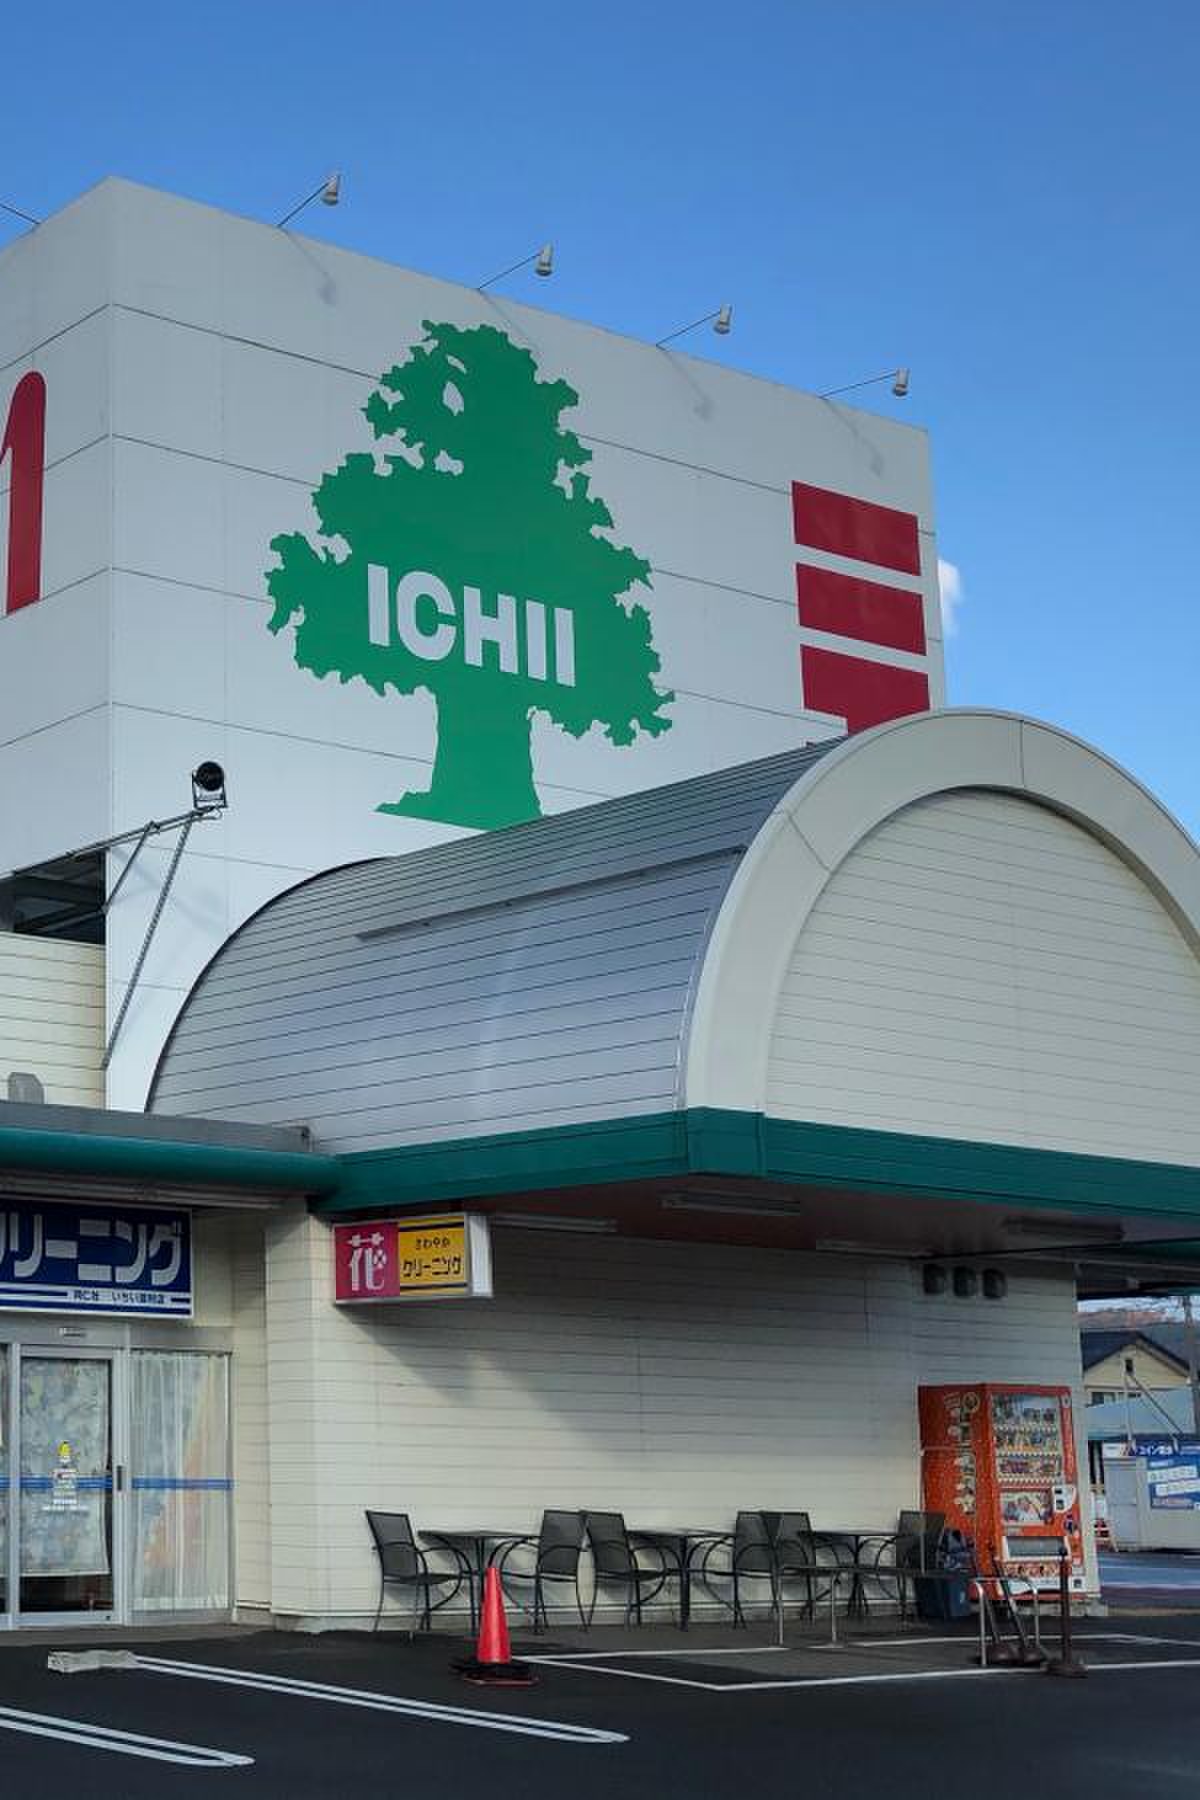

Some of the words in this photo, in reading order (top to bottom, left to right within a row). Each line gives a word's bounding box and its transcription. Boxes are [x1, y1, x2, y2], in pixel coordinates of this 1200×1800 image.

[367, 563, 576, 687] ICHII
[347, 1232, 387, 1291] 花
[402, 1256, 462, 1277] クリーニング
